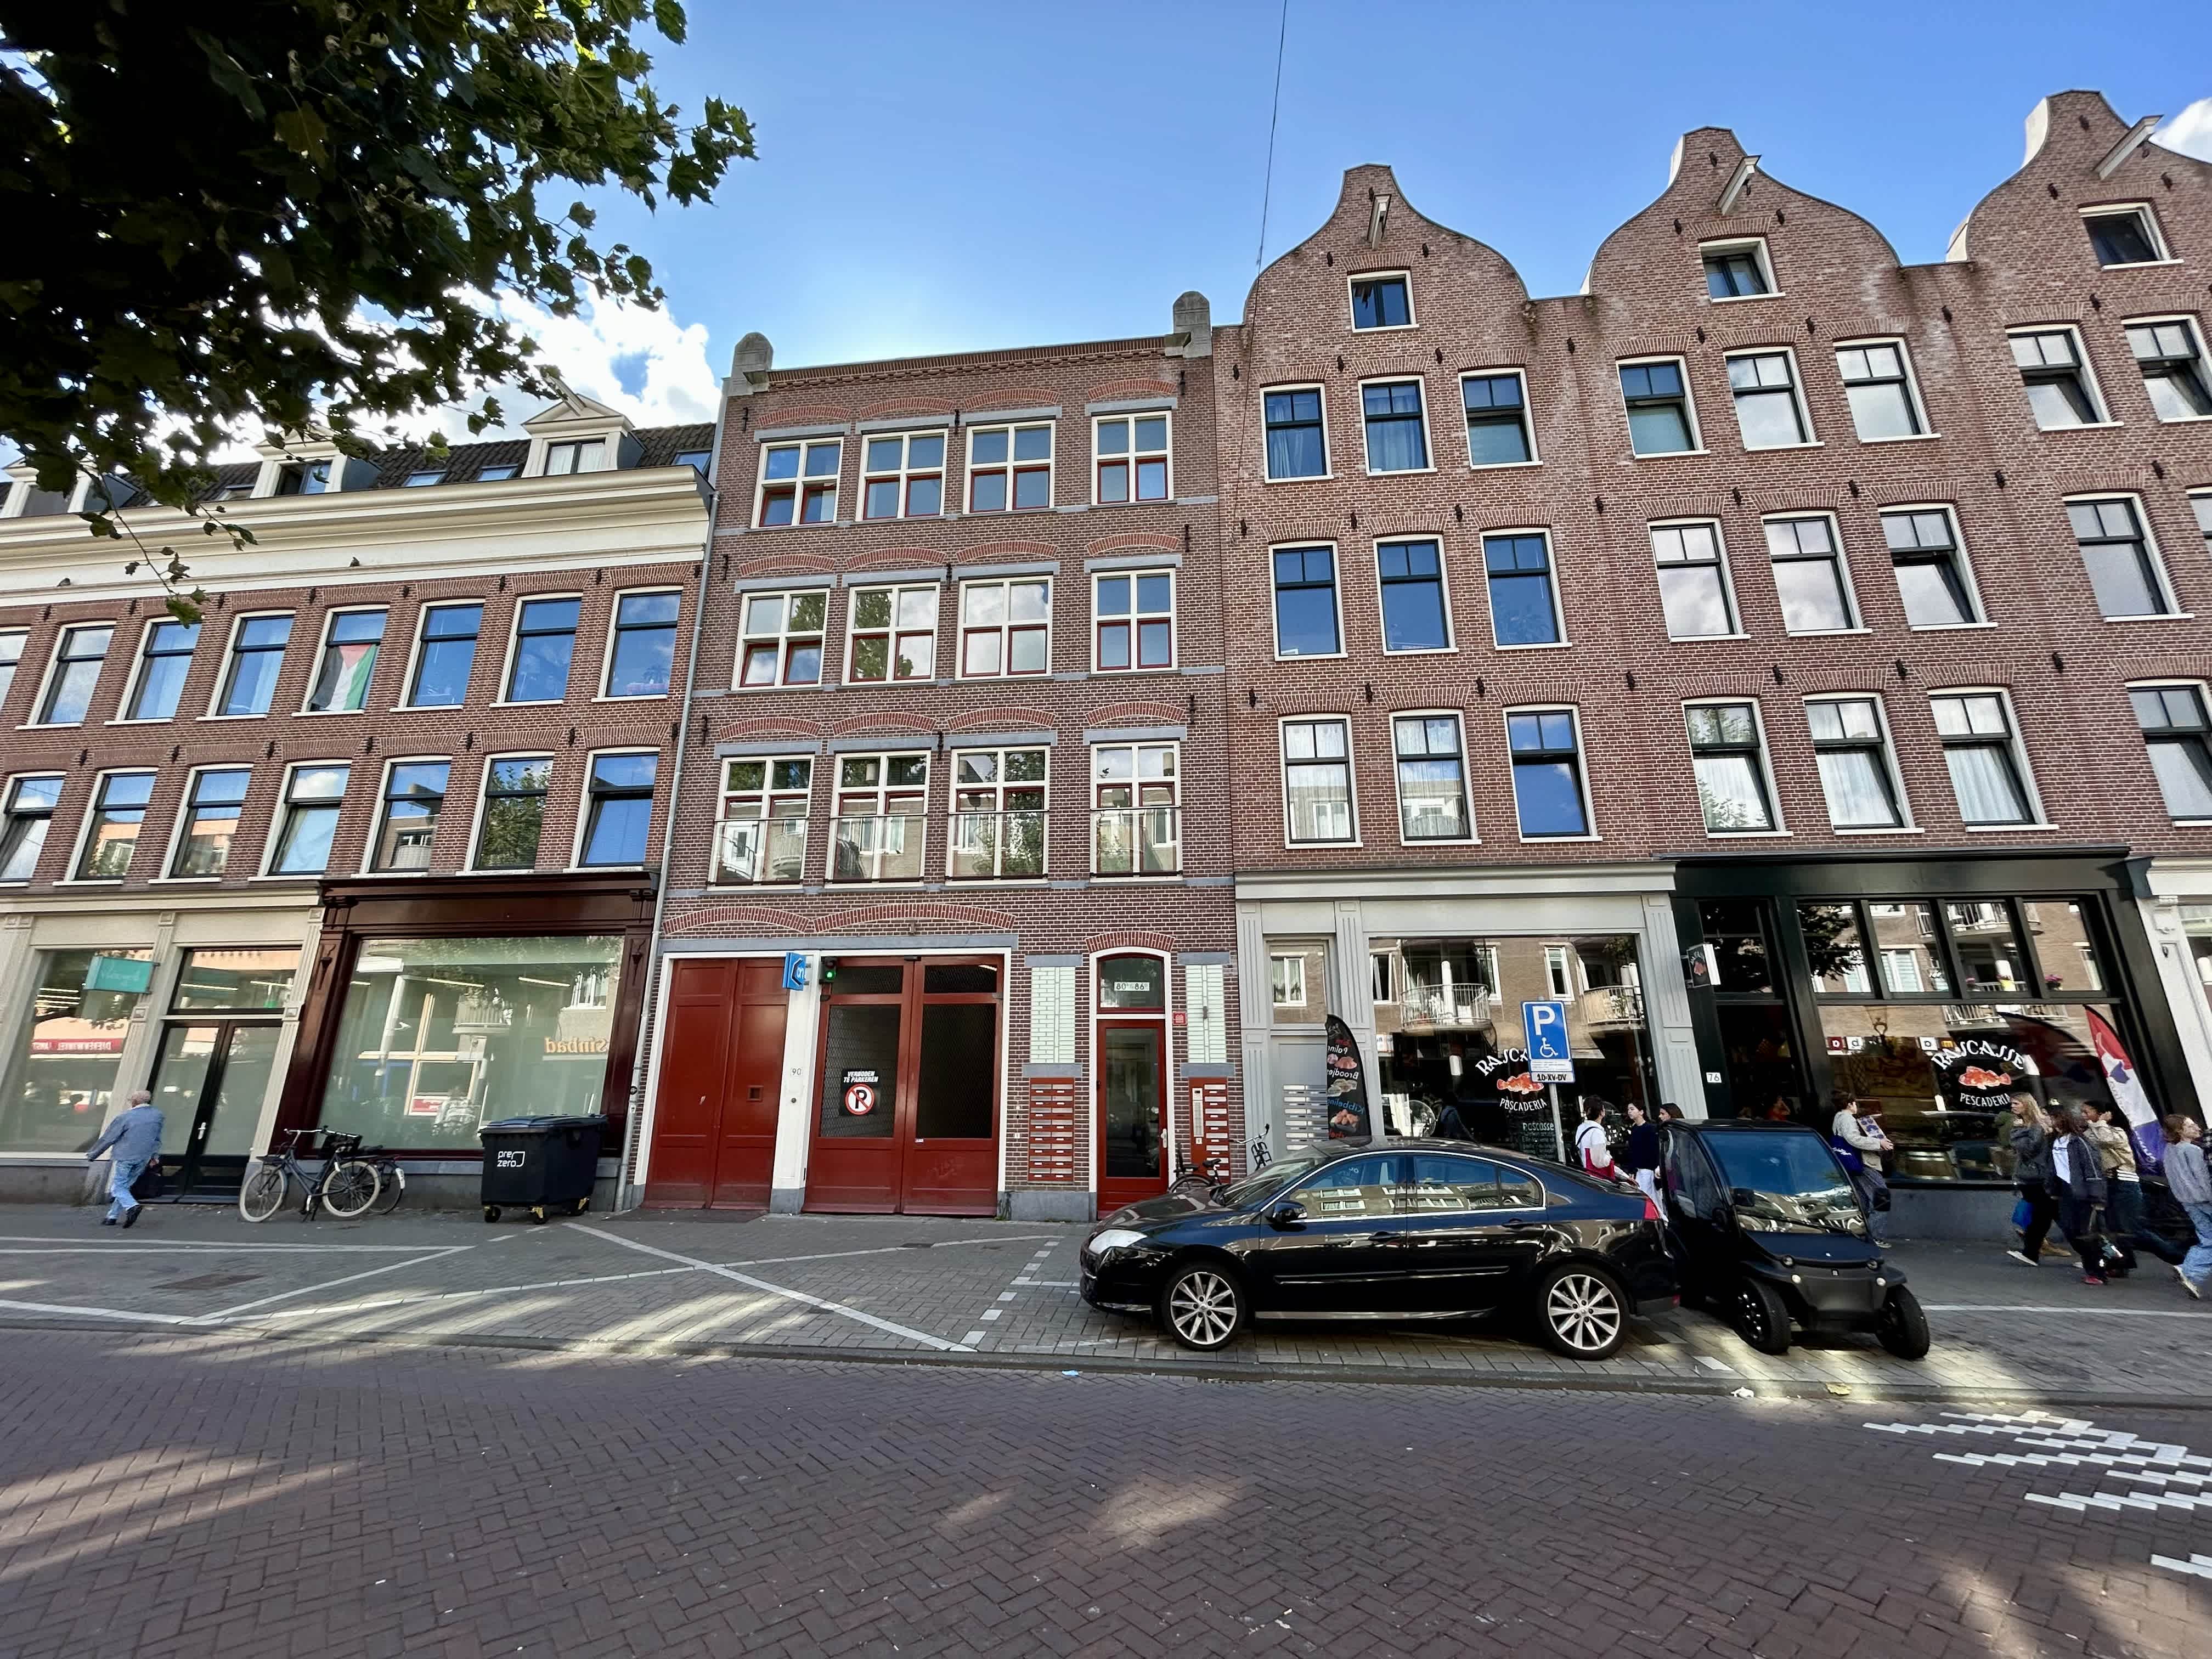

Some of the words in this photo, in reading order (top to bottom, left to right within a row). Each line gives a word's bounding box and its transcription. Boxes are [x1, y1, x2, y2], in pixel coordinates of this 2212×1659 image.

[1532, 1006, 1555, 1036] P
[1475, 1047, 1528, 1076] RASCA
[1931, 1040, 2024, 1070] RASCASSE
[791, 1067, 803, 1076] 90
[1708, 1073, 1720, 1082] 76
[1499, 1097, 1548, 1111] PESCADERIA
[1960, 1092, 2011, 1107] PESCADERIA
[498, 1151, 512, 1159] pre
